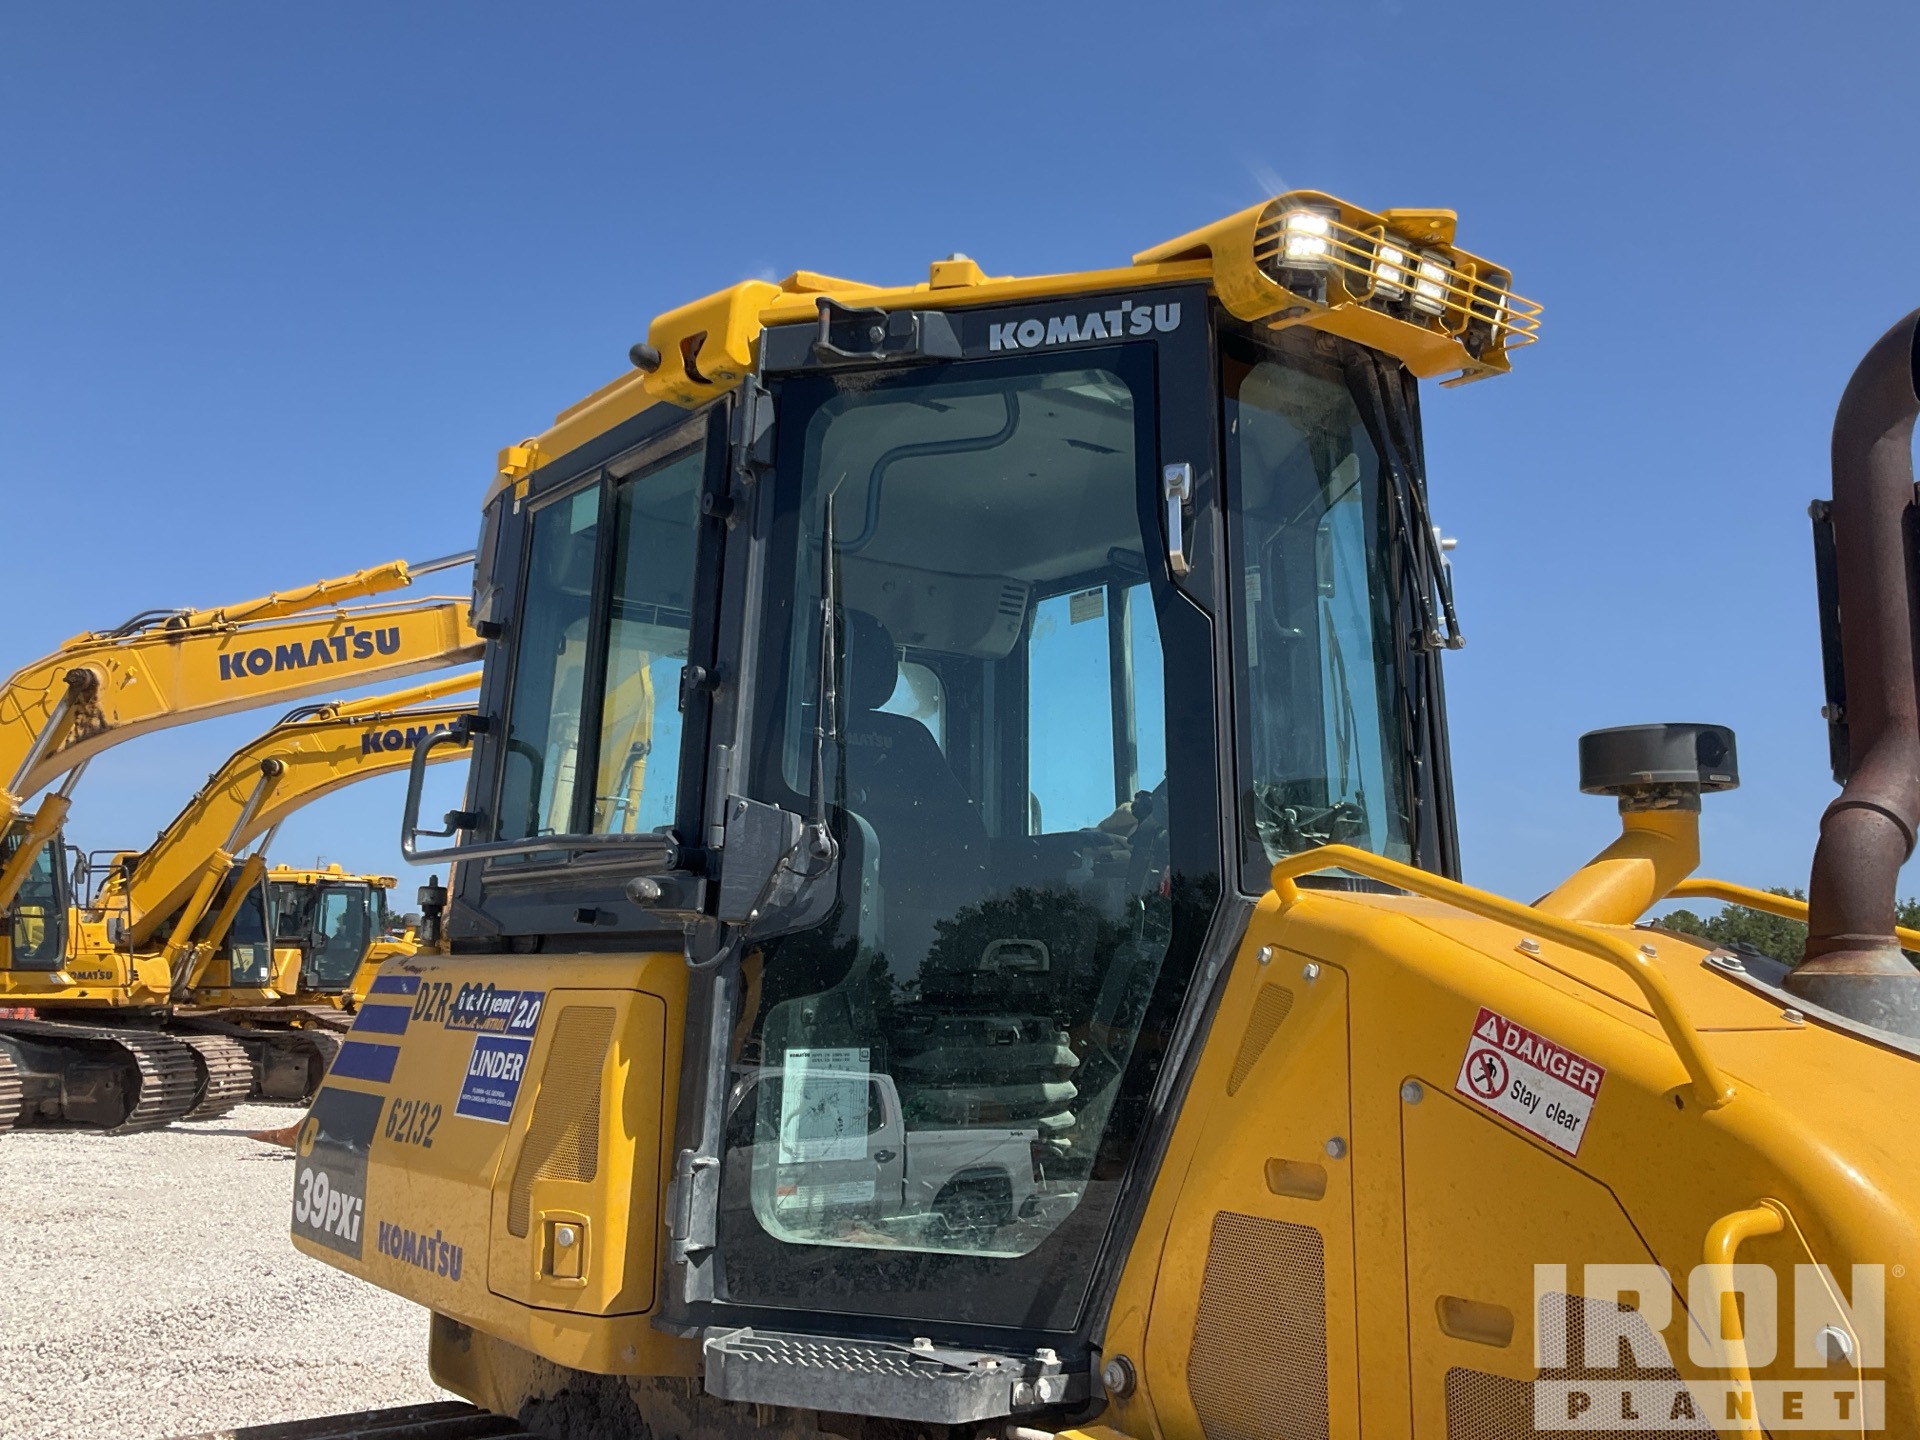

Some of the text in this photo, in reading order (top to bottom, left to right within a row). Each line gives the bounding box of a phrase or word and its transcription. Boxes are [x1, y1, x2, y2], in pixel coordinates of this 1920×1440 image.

[989, 300, 1181, 351] KOMATSU
[219, 626, 401, 681] KOMATSU
[69, 969, 113, 980] OMATSU
[511, 999, 541, 1029] 2.0
[469, 1049, 524, 1081] LINDER
[1502, 1026, 1600, 1094] DANGER
[385, 1096, 443, 1149] 62132
[1510, 1079, 1580, 1132] Stay clear
[295, 1167, 363, 1243] 39PXi
[377, 1220, 463, 1281] KOMATSU
